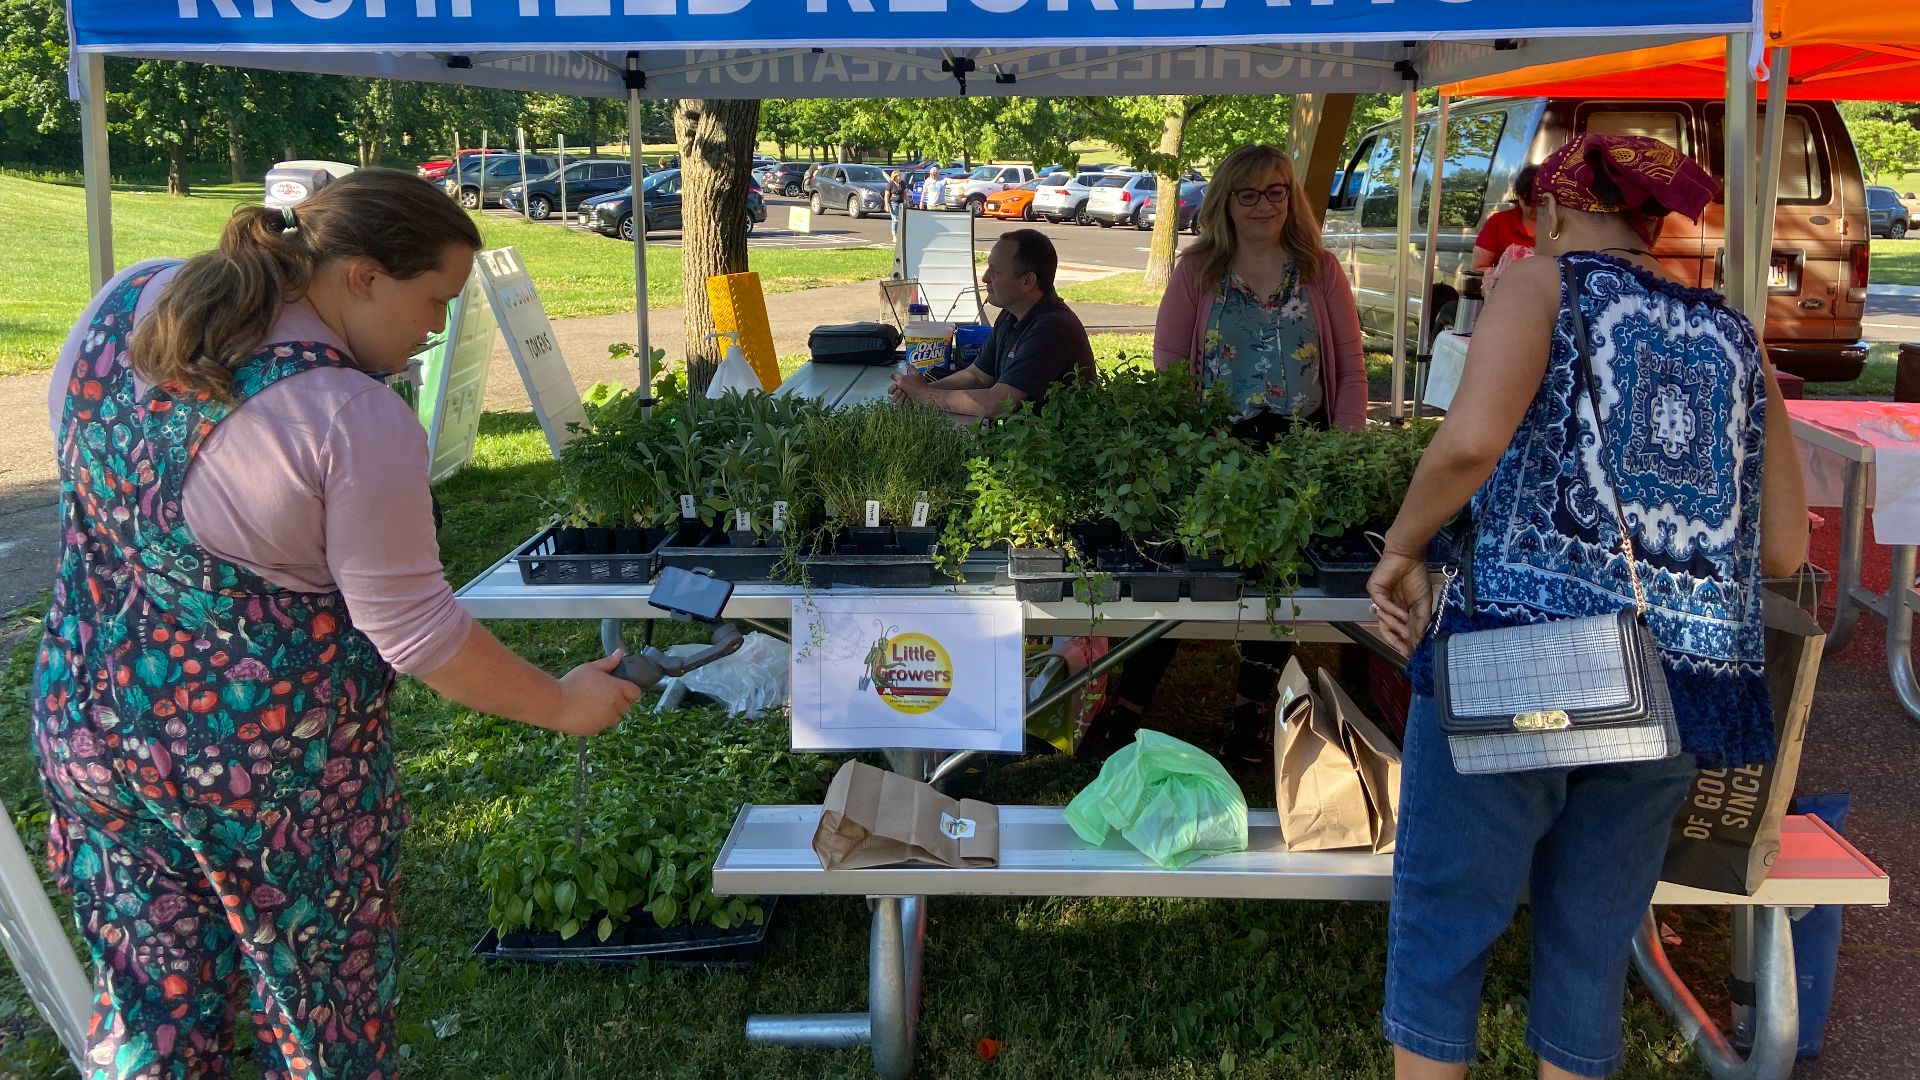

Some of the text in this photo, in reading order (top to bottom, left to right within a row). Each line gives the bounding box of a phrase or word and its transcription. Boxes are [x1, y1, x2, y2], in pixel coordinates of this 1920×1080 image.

[525, 332, 552, 358] TOKENS
[892, 643, 936, 662] Little
[876, 665, 951, 682] Growers
[1683, 814, 1713, 840] OF
